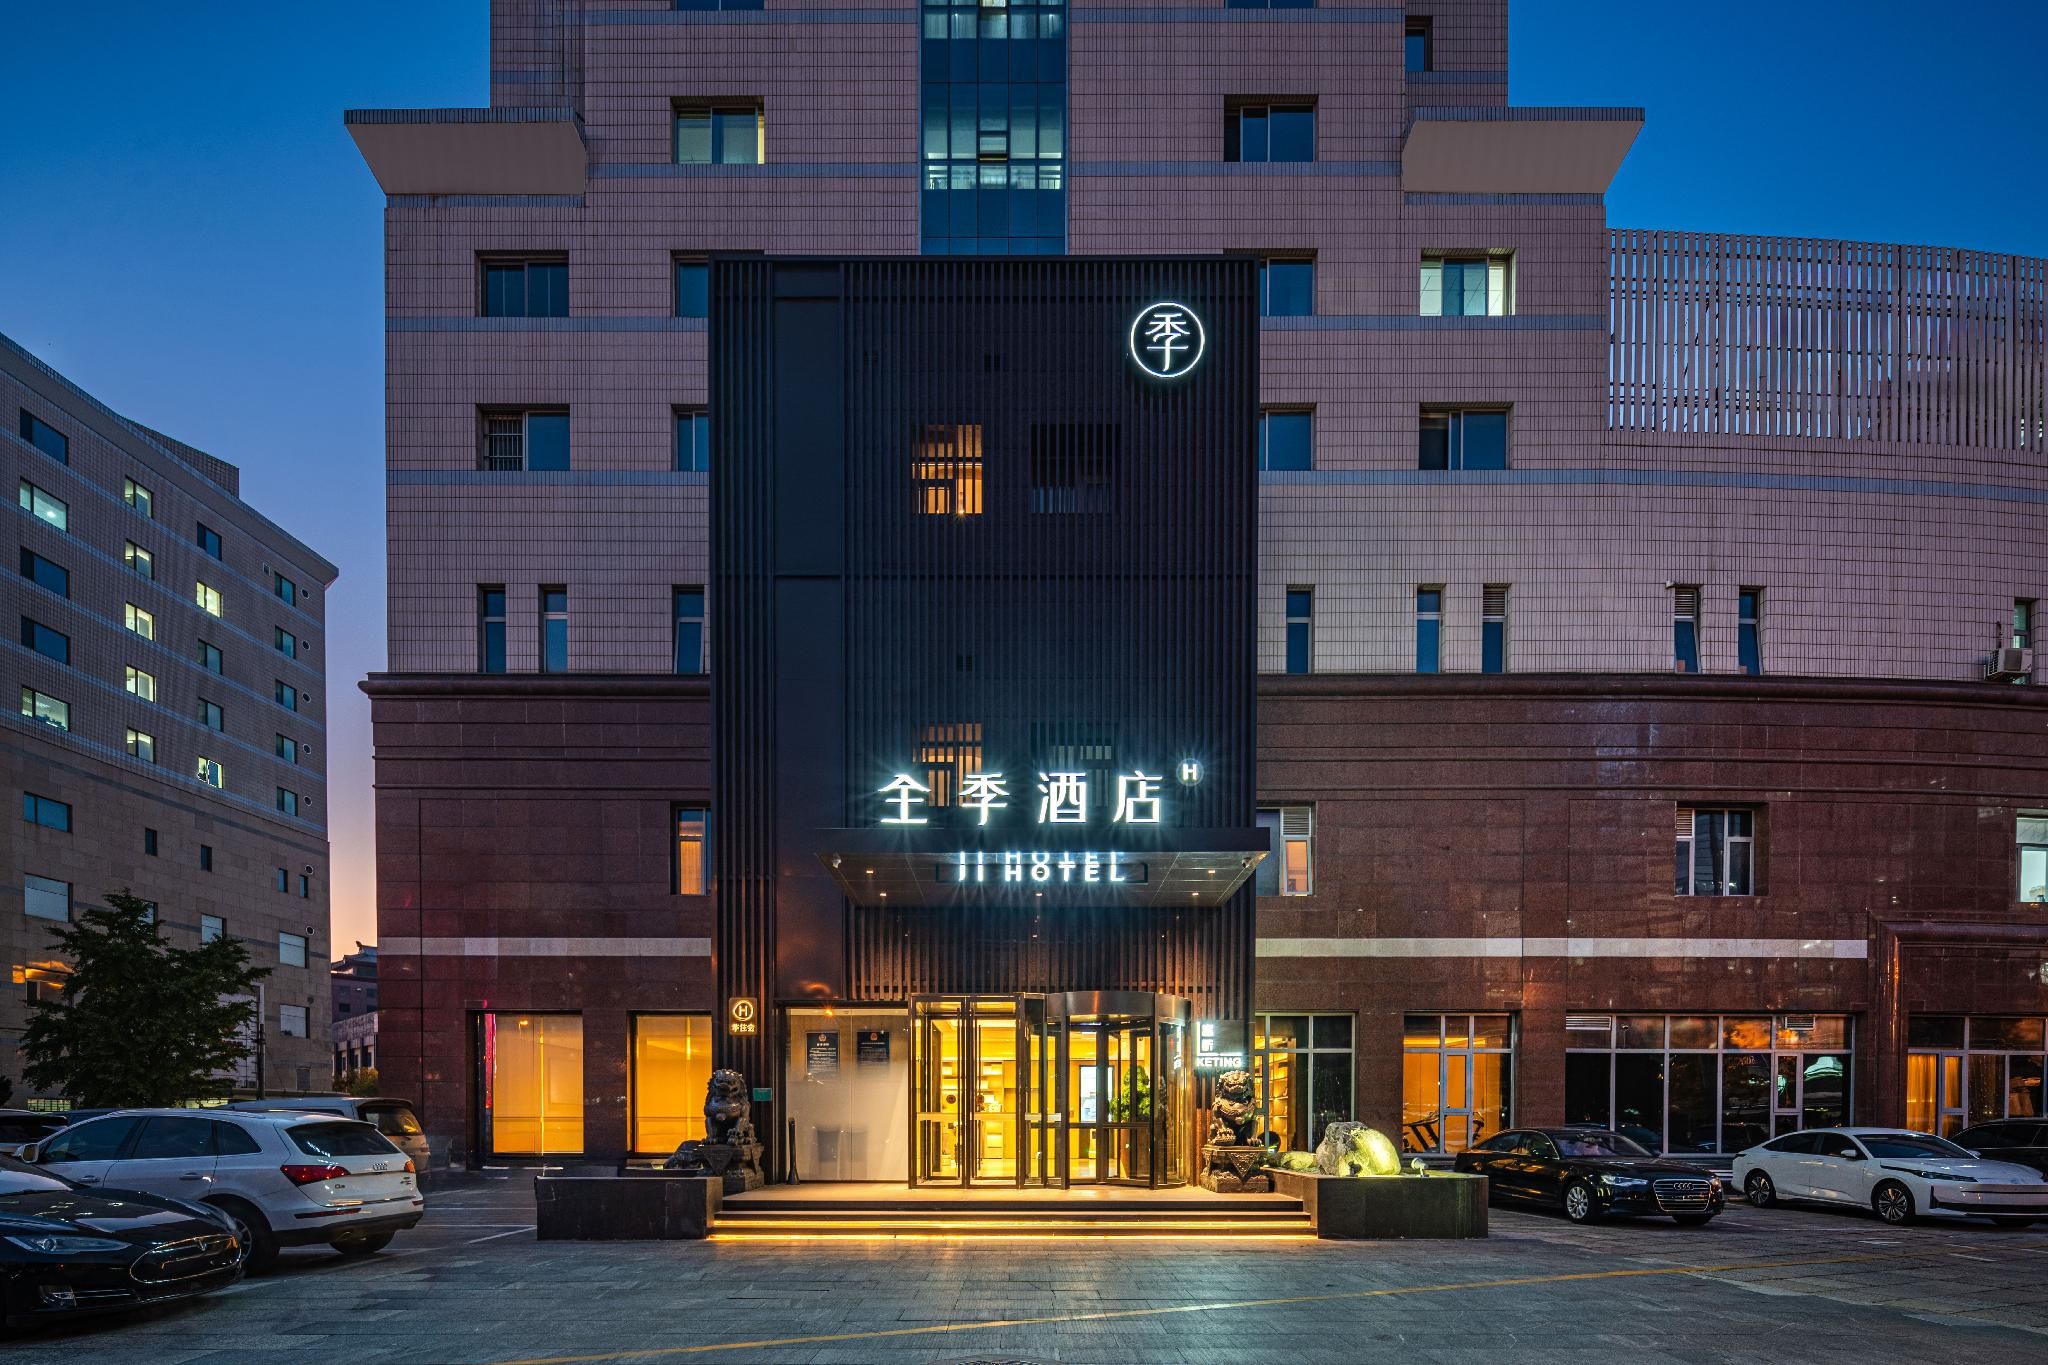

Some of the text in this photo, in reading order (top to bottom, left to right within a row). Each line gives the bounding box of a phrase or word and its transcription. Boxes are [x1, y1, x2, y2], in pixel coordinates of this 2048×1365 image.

[1145, 313, 1191, 372] 季
[1182, 763, 1197, 781] H
[877, 770, 1163, 826] 全季酒店
[958, 863, 1125, 882] JI HOTEL
[738, 1005, 748, 1017] H
[1196, 1056, 1243, 1068] KETING
